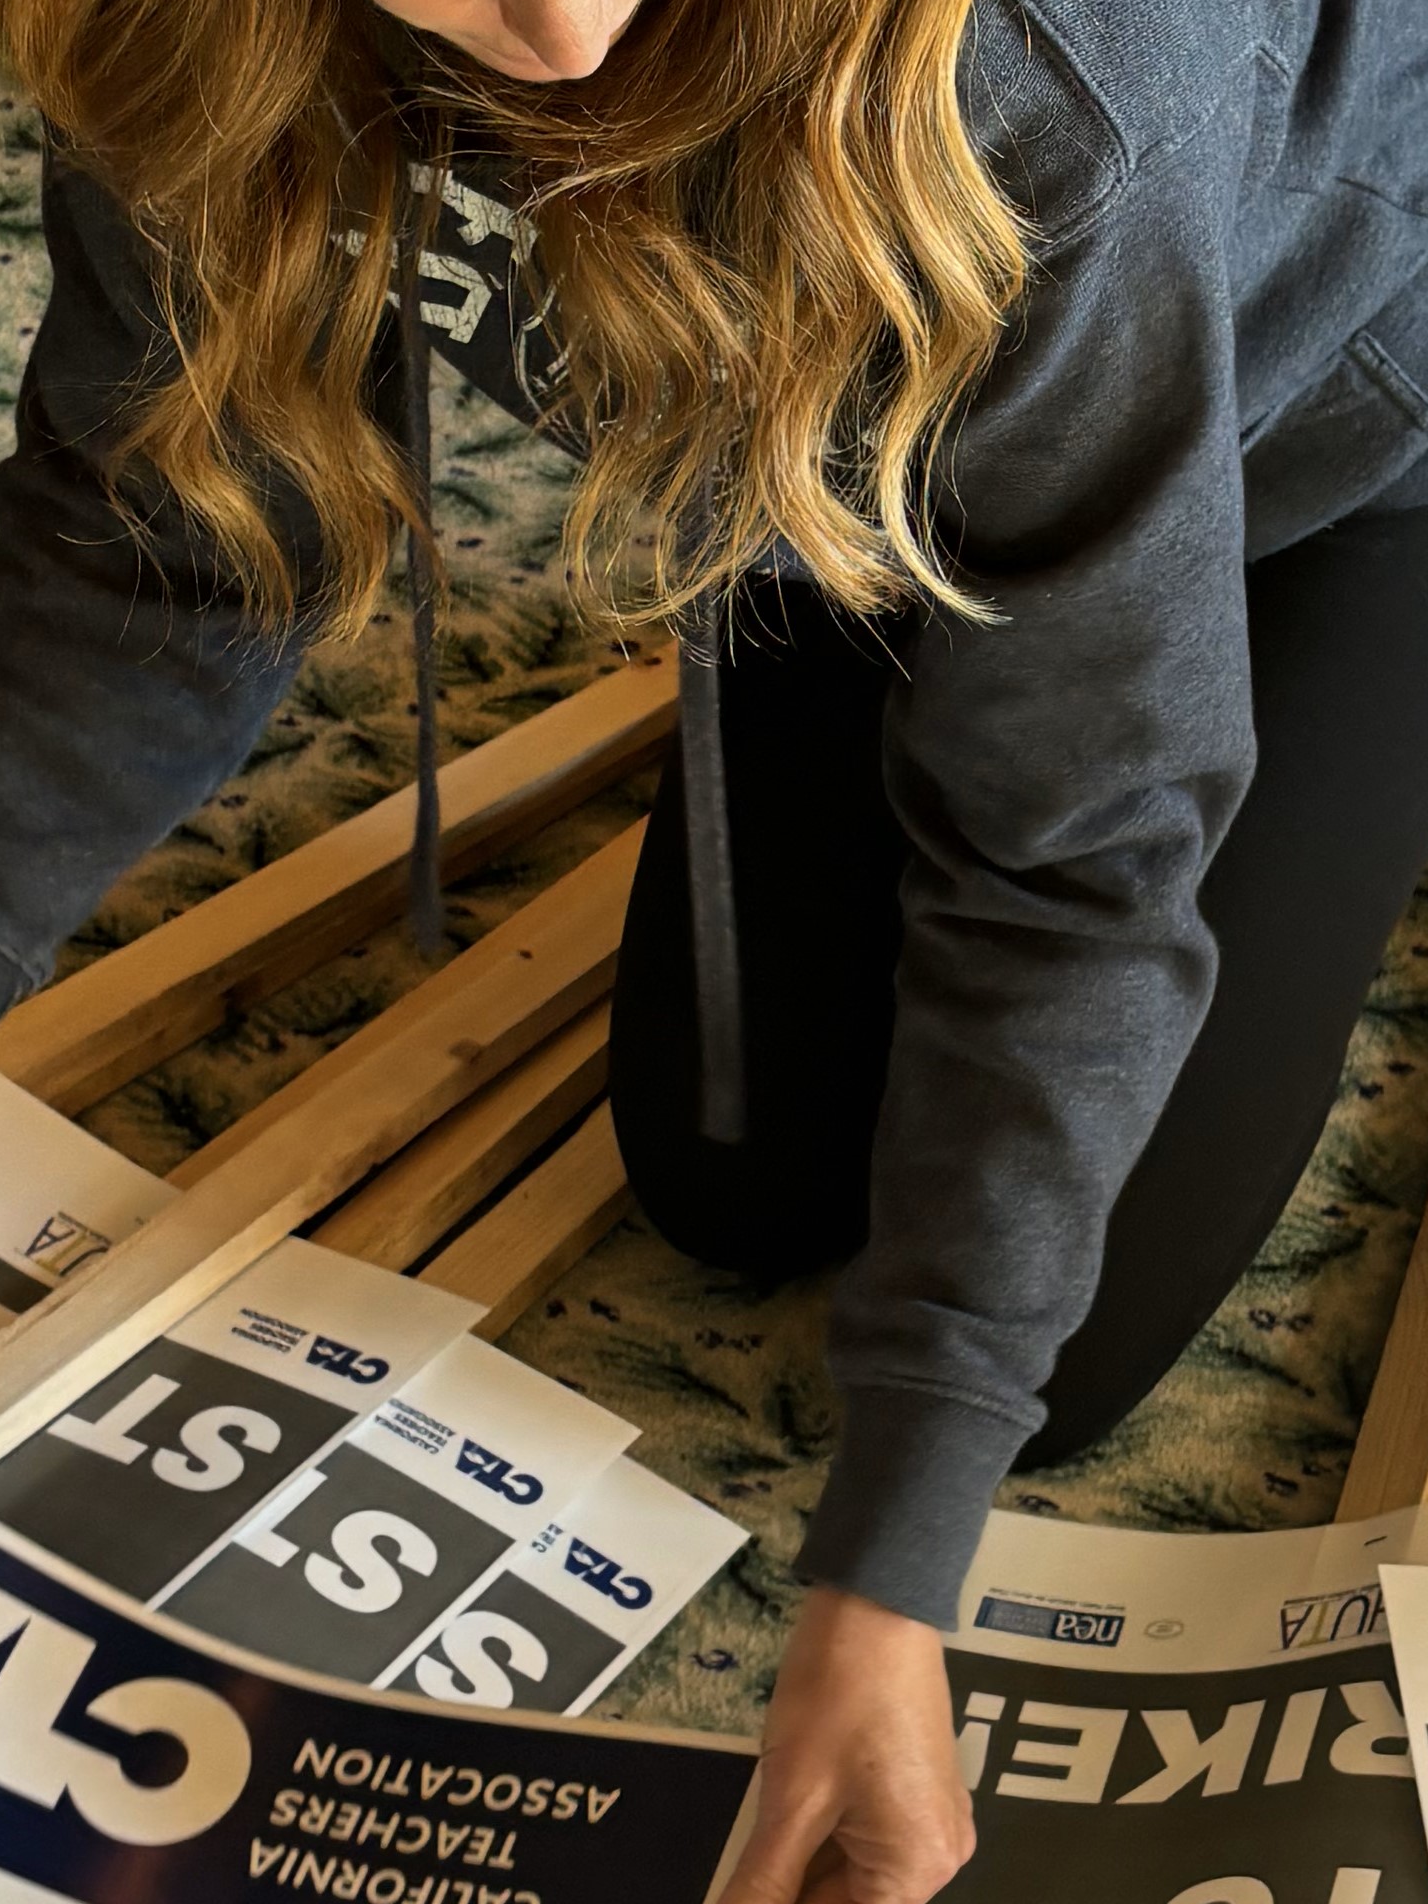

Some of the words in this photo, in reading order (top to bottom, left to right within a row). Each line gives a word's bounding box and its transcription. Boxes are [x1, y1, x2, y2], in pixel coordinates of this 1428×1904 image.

[305, 1334, 390, 1384] CTA
[47, 1374, 281, 1491] ST
[455, 1438, 544, 1506] CTA
[231, 1468, 438, 1614] ST
[563, 1537, 653, 1611] CTA
[1055, 1612, 1119, 1644] nea
[293, 1738, 621, 1824] ASSOCATION
[957, 1680, 1416, 1804] RIKE!
[269, 1789, 517, 1870] TEACHERS
